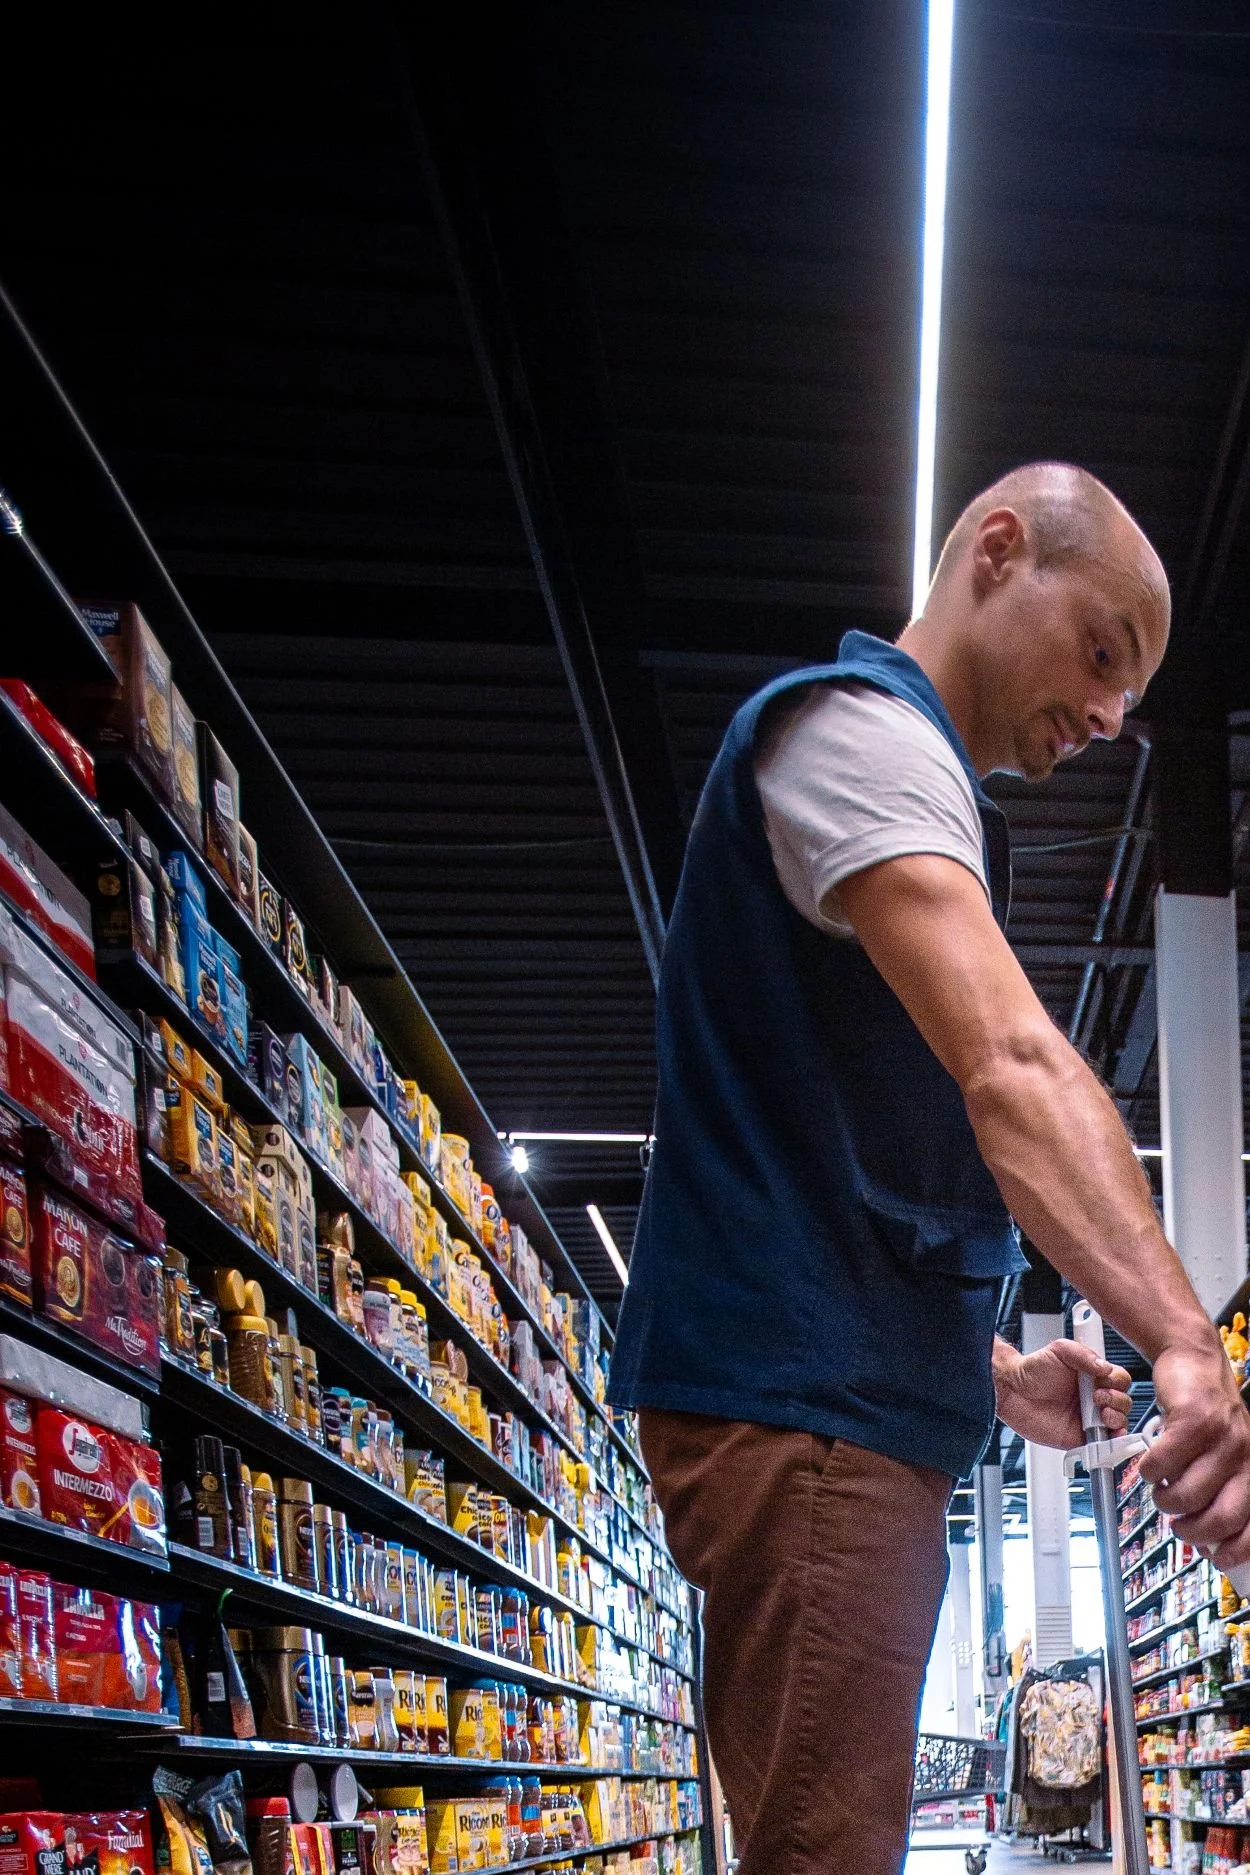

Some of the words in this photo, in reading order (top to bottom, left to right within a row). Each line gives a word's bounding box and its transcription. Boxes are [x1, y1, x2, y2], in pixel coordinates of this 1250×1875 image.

[58, 1044, 108, 1097] PLANTATION
[53, 1469, 113, 1502] INTERMEZZO
[107, 1829, 145, 1852] Familial
